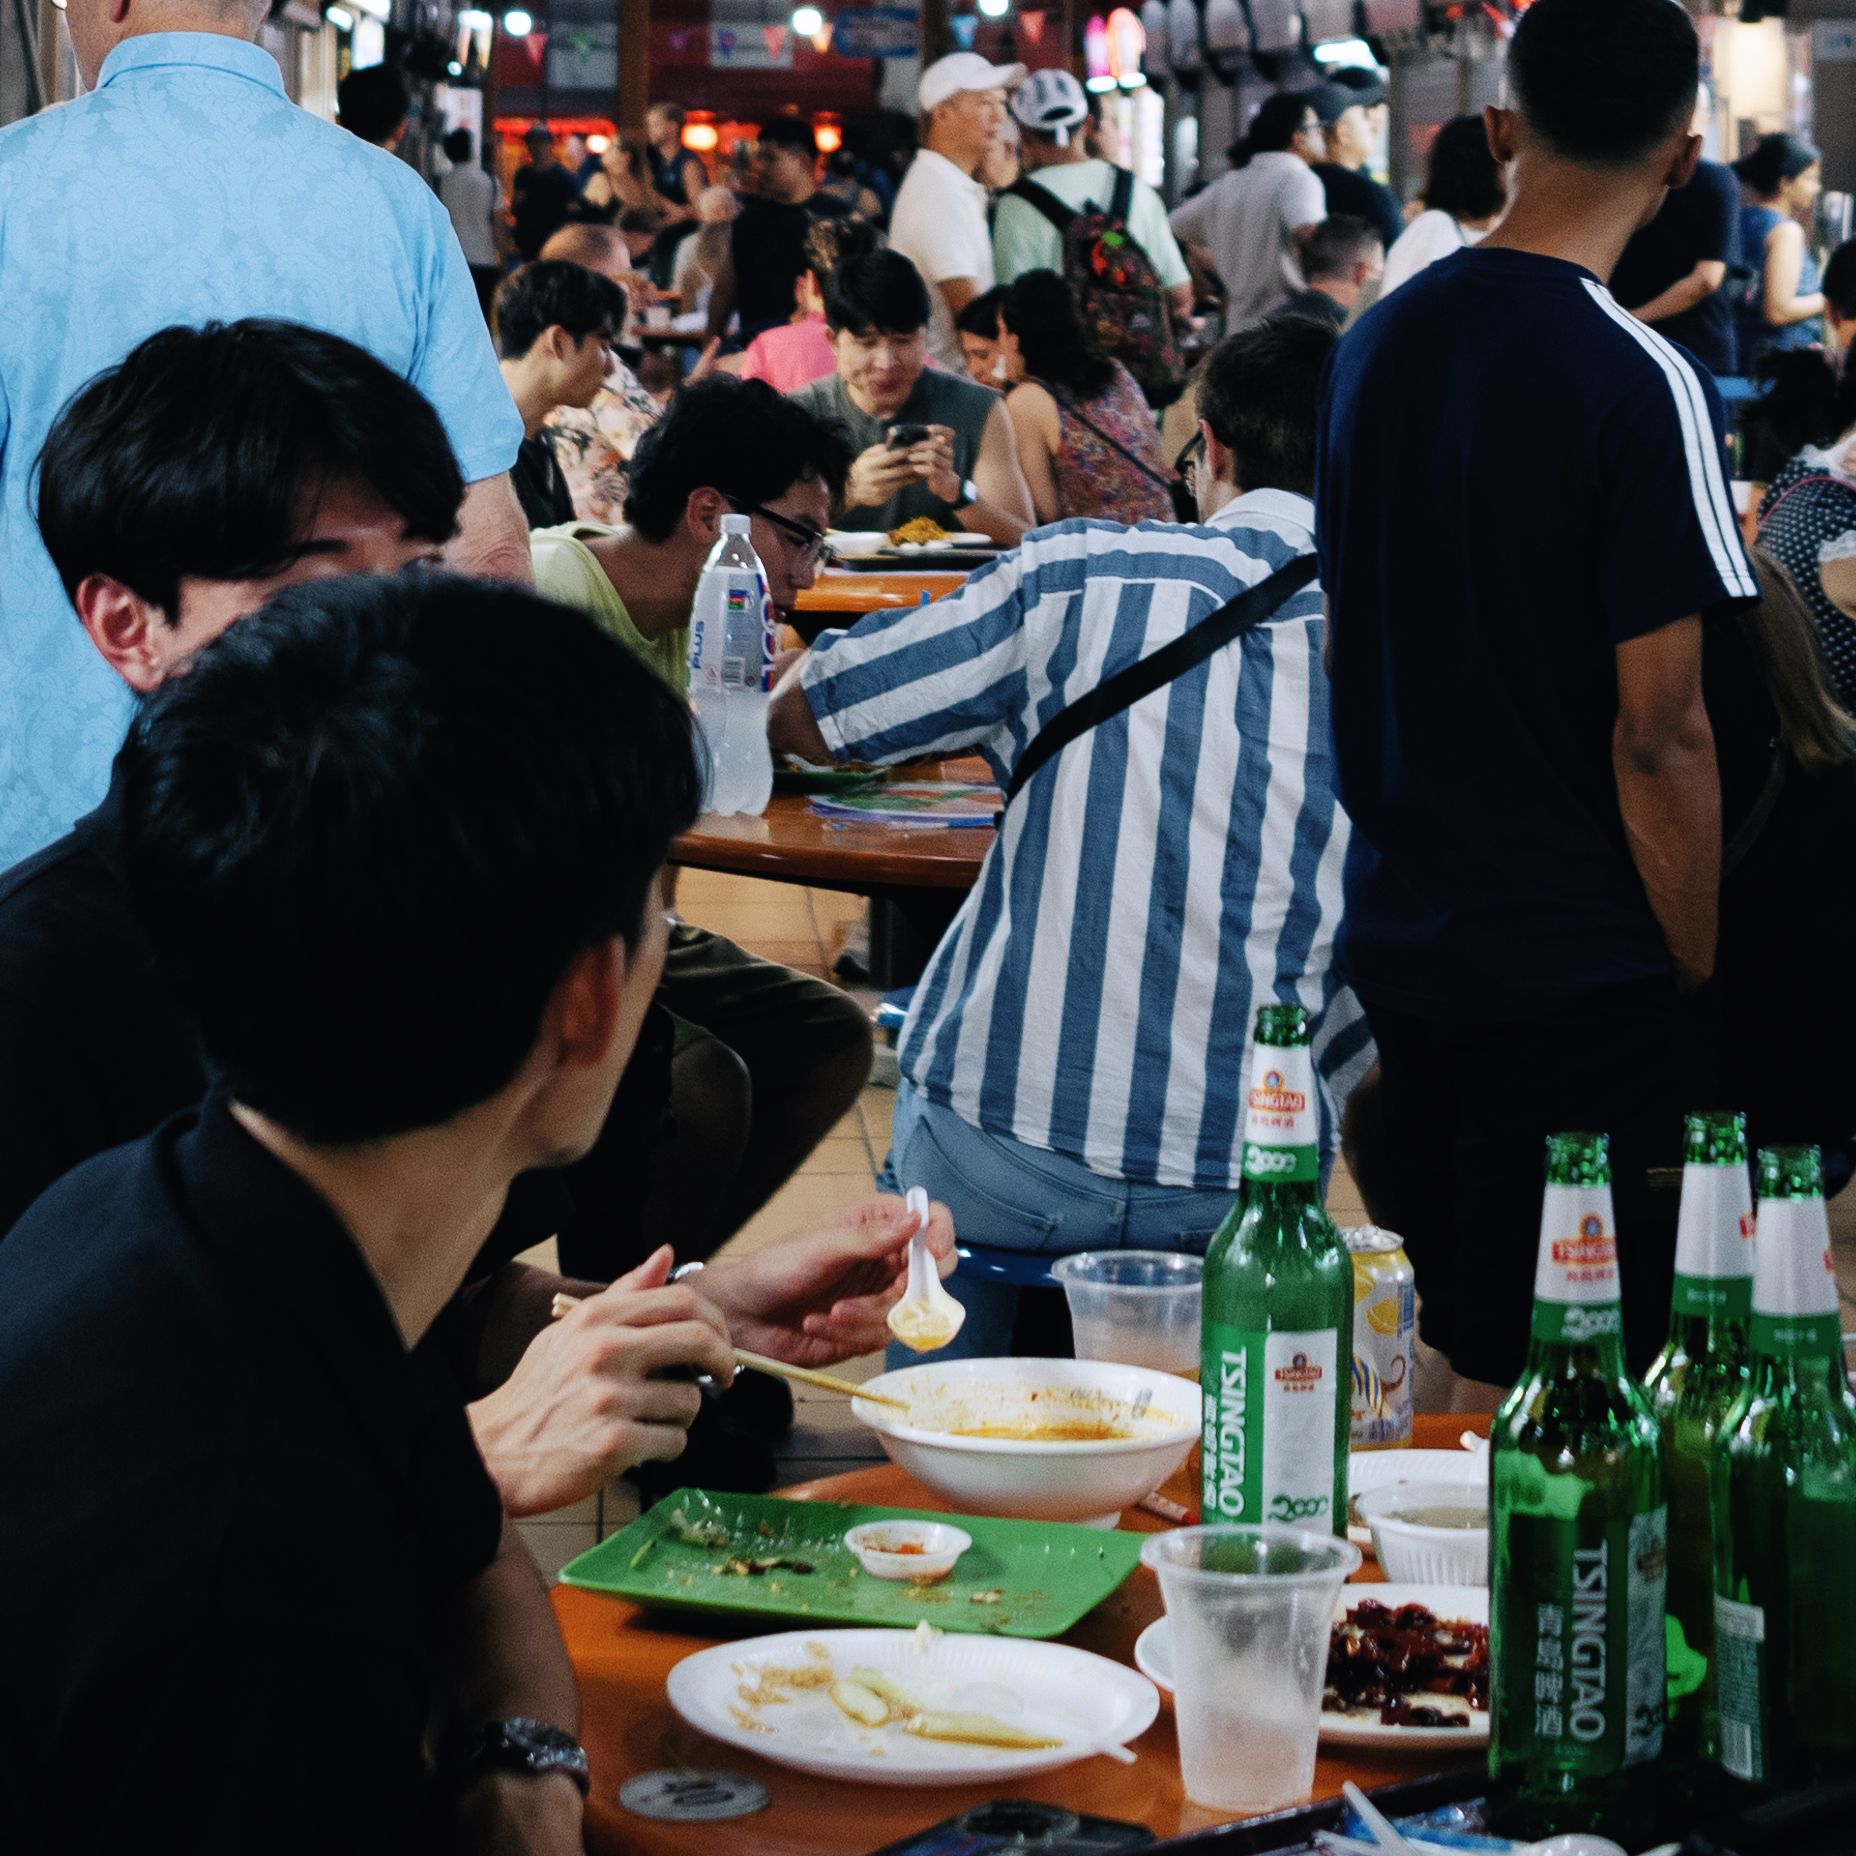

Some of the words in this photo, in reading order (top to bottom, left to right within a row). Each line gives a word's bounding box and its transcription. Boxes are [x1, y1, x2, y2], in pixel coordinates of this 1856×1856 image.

[691, 620, 704, 669] PLUS
[1218, 1347, 1246, 1517] TSINGTAO
[1570, 1538, 1608, 1742] TSINGTAO
